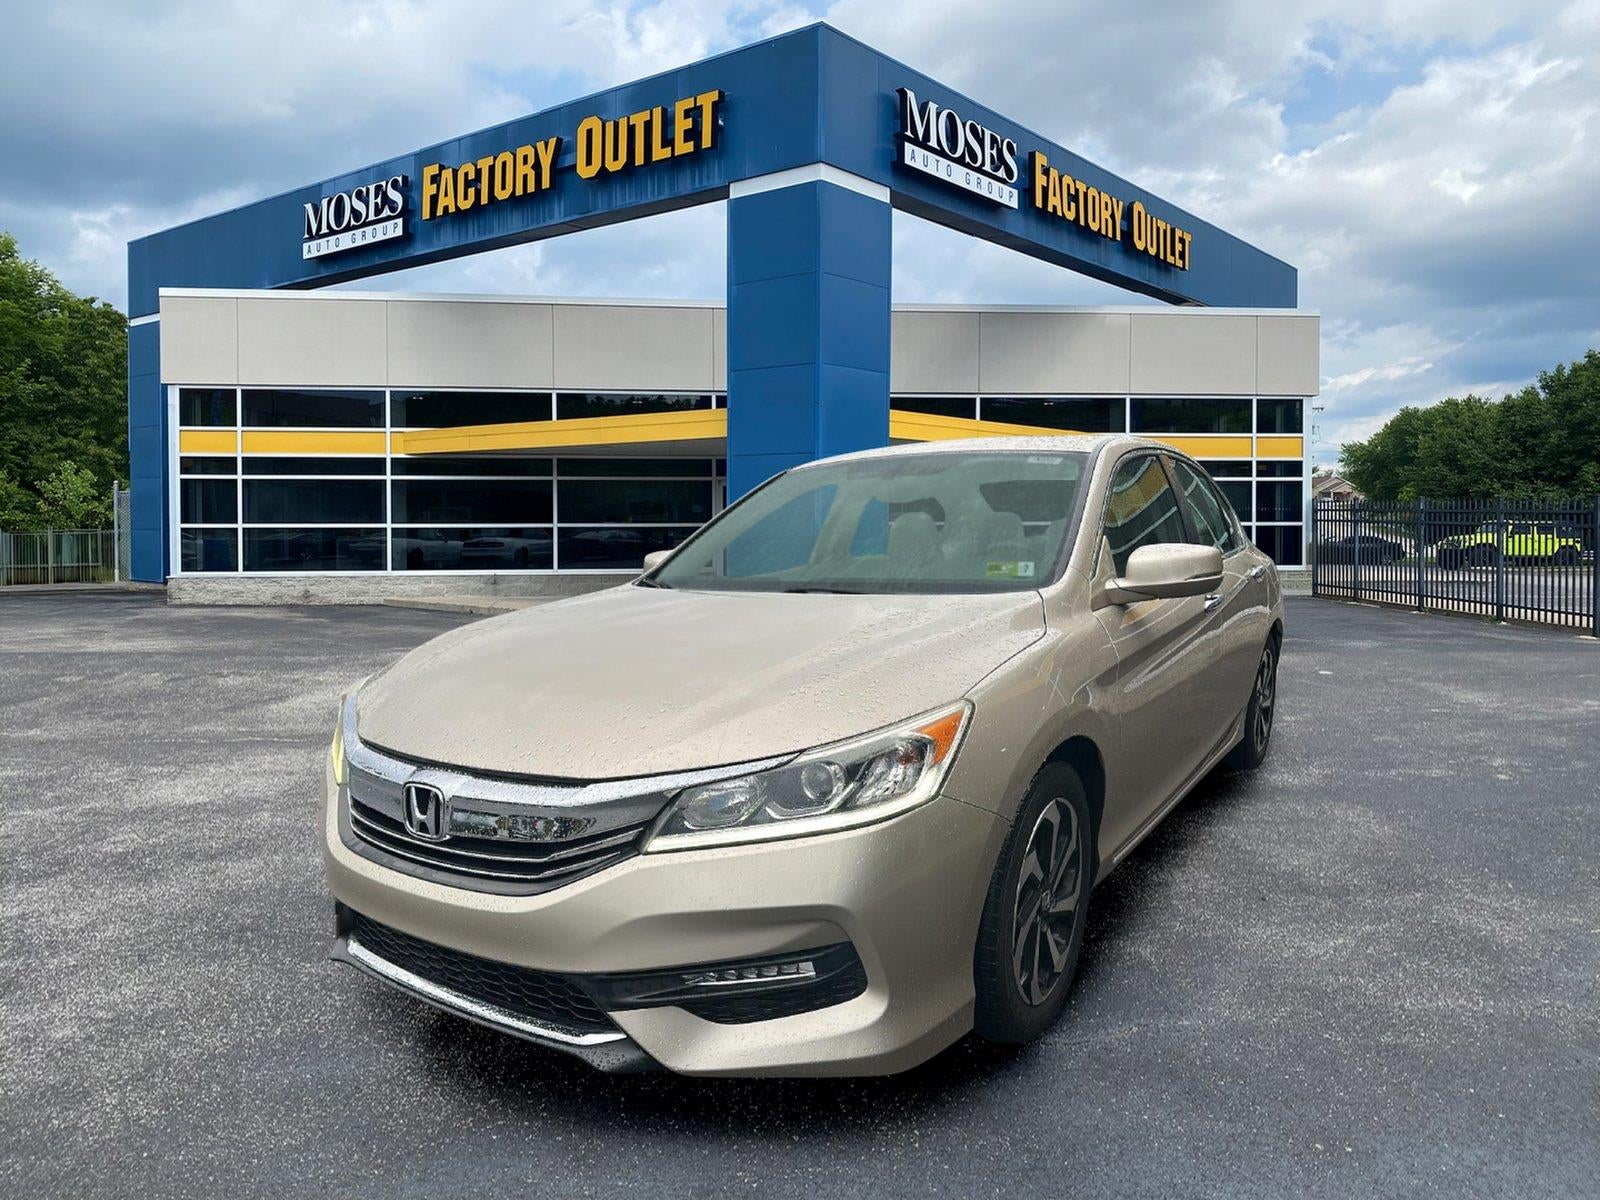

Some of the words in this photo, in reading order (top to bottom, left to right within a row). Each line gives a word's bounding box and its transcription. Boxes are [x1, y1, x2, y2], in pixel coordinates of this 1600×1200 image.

[421, 137, 559, 220] FACTORY
[576, 89, 719, 180] OUTLET
[904, 88, 1018, 183] MOSES
[303, 175, 403, 239] MOSES
[910, 149, 953, 178] AUTO
[965, 172, 1014, 202] GROUP
[1034, 151, 1124, 241] FACTORY
[1132, 201, 1192, 271] OUTLET
[307, 237, 340, 255] AUTO
[351, 222, 399, 244] GROUP
